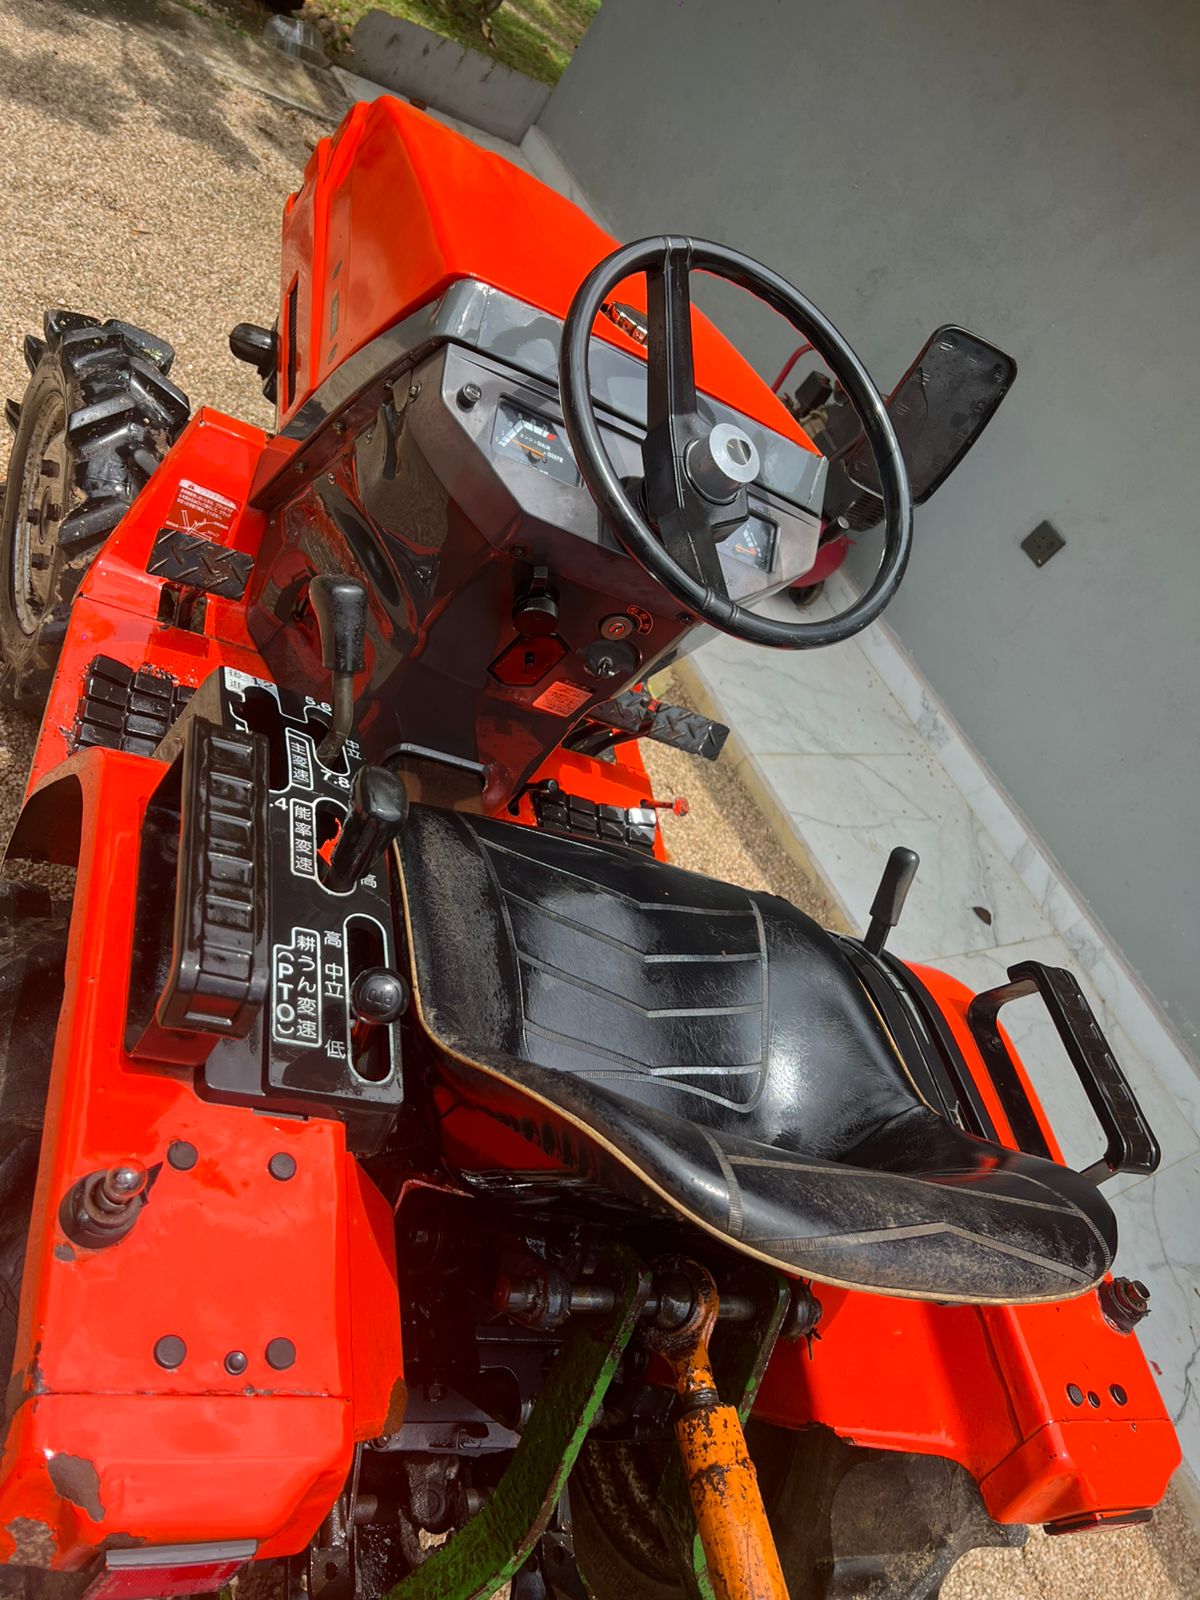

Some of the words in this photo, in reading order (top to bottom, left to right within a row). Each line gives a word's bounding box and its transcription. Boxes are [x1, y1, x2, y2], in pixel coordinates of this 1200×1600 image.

[290, 741, 310, 784] 主変速
[320, 768, 351, 788] 7.8
[294, 804, 314, 873] 能率変速
[360, 873, 377, 889] 高
[323, 930, 342, 948] 高
[296, 934, 317, 1039] 耕うん変速
[324, 962, 344, 999] 中立
[324, 1039, 347, 1060] 低
